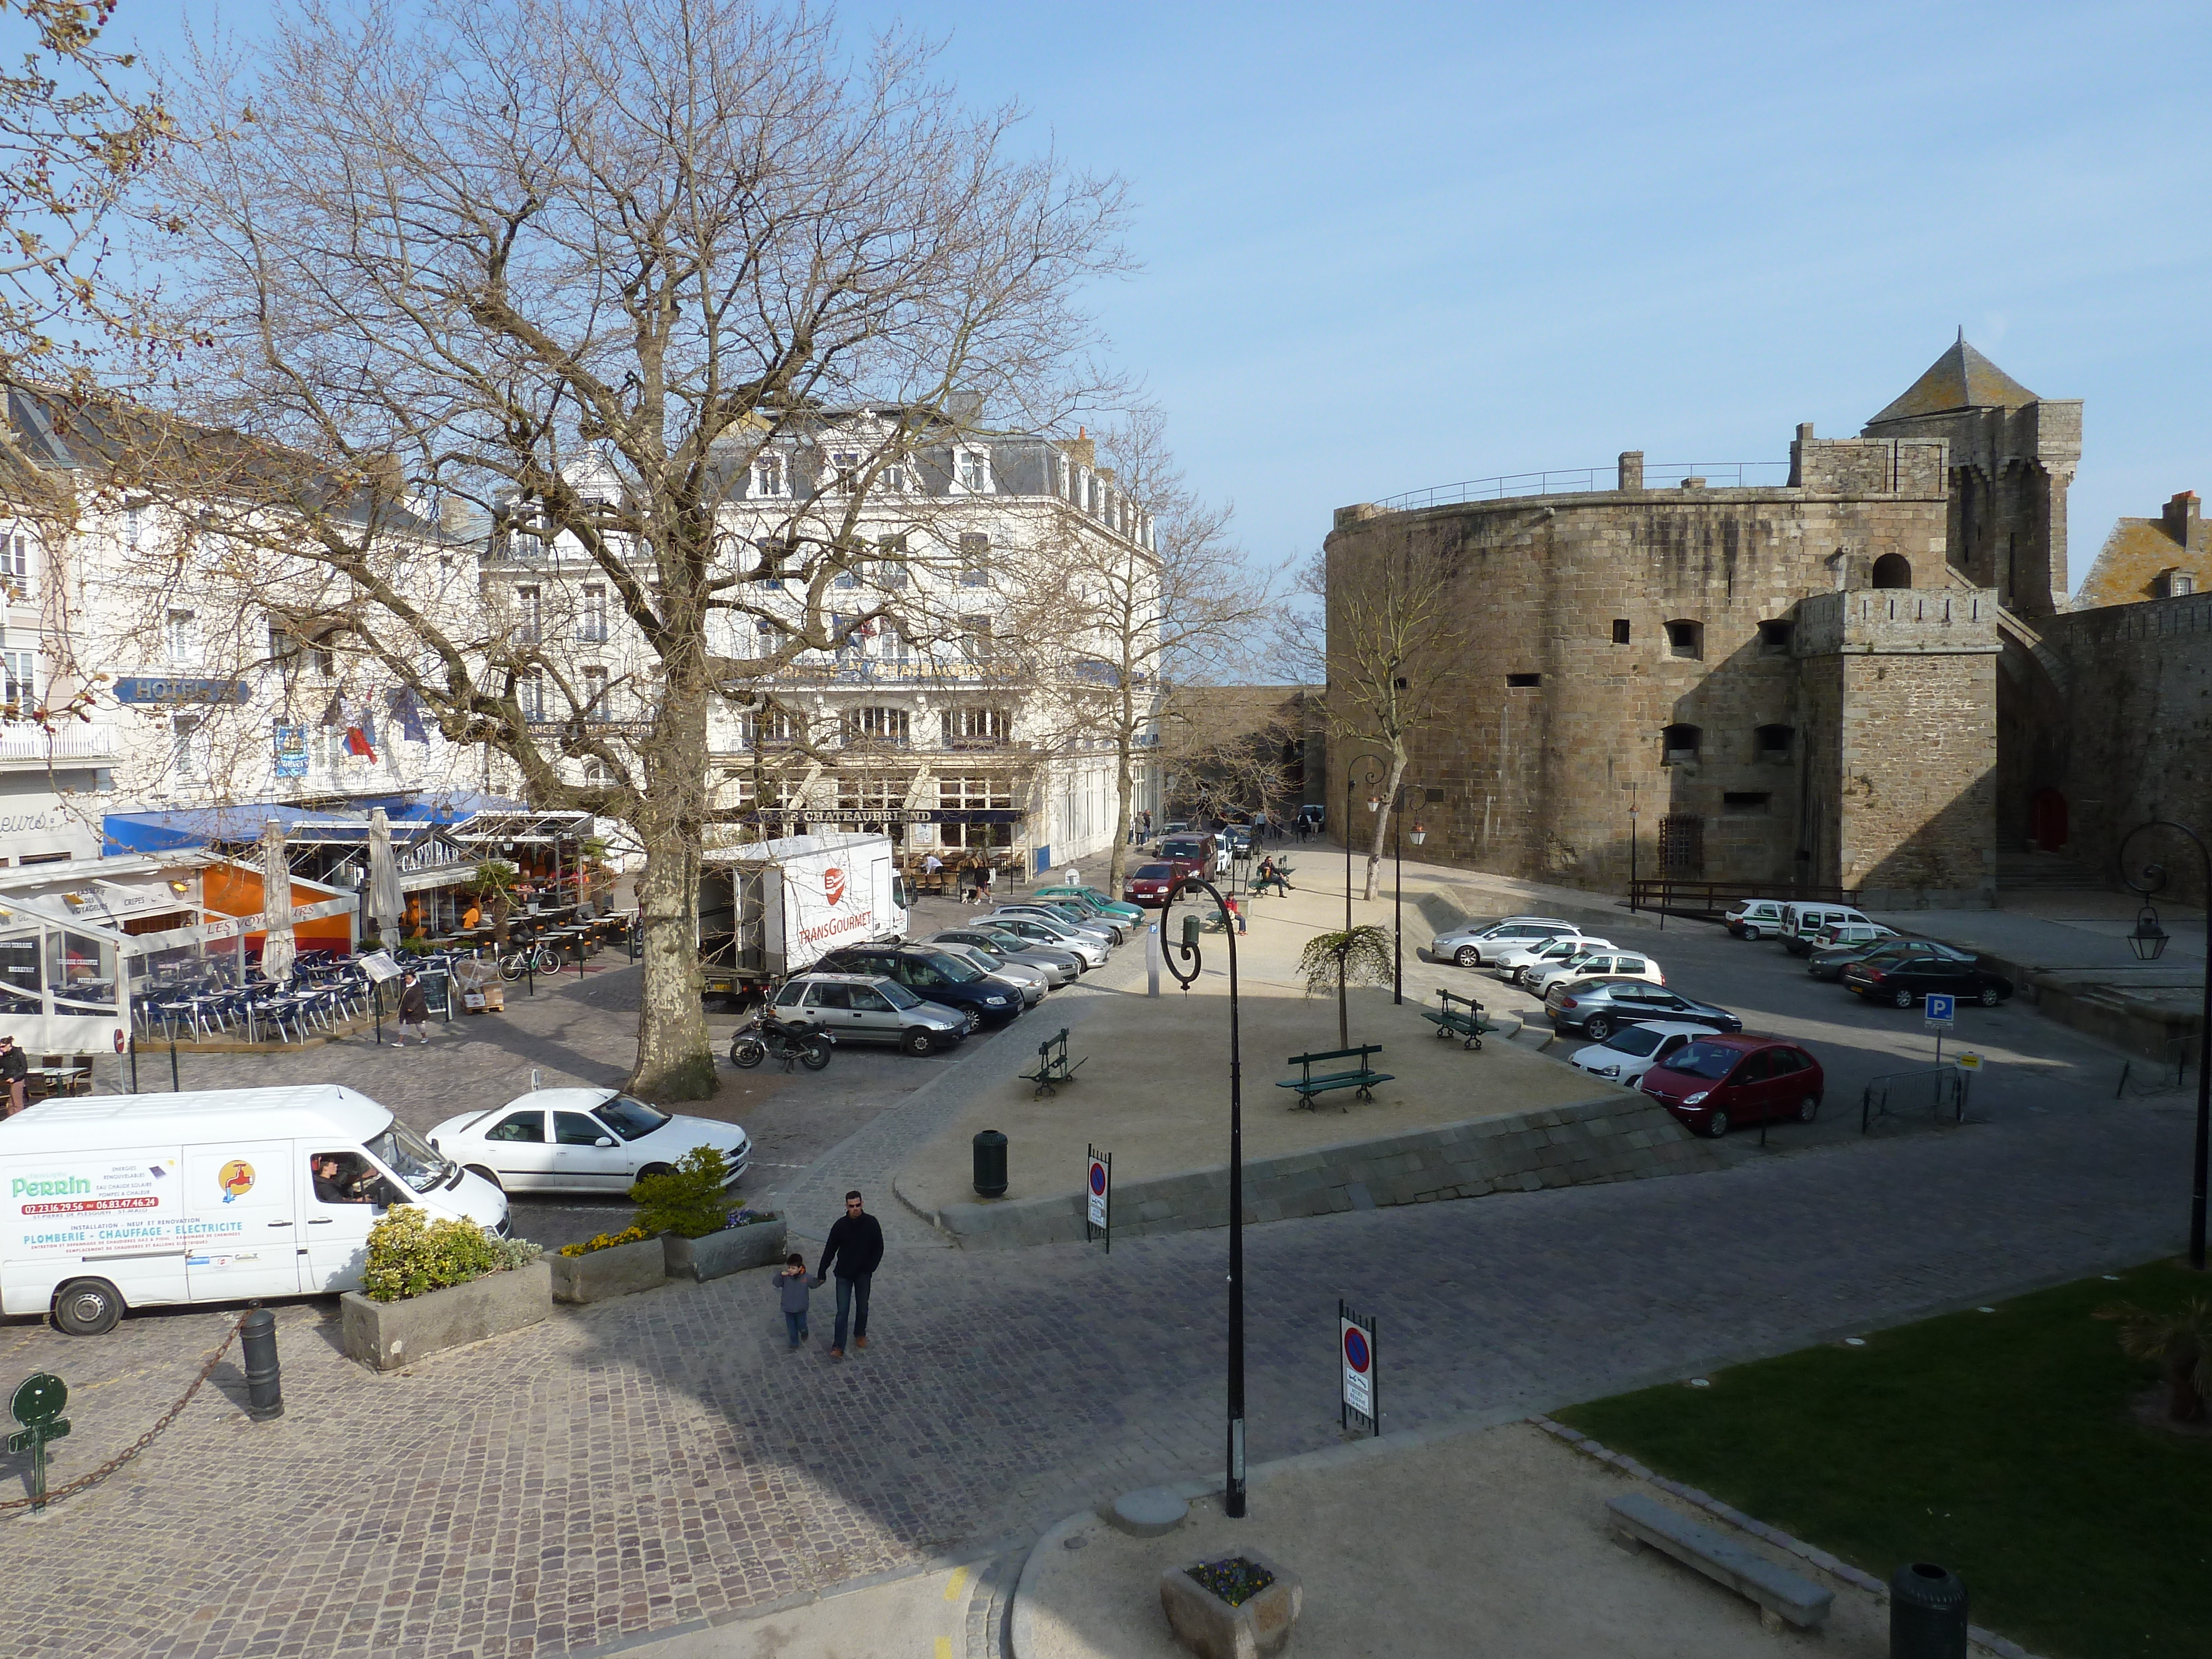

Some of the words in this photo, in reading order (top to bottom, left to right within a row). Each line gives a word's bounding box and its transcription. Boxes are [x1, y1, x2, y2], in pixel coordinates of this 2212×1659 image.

[804, 811, 931, 822] CHATEAUBRIND
[434, 841, 460, 867] BAR
[76, 887, 106, 896] RASSERIE
[207, 921, 231, 935] LES
[1933, 999, 1946, 1015] P
[25, 1202, 84, 1214] 02.23.16.29.56
[96, 1198, 155, 1209] 06.83.47.46.24
[24, 1232, 86, 1244] PLOMBERIE
[98, 1227, 162, 1239] CHAUFFAGE
[175, 1222, 243, 1234] ELECTRICITE
[71, 1223, 118, 1231] INSTALLATION
